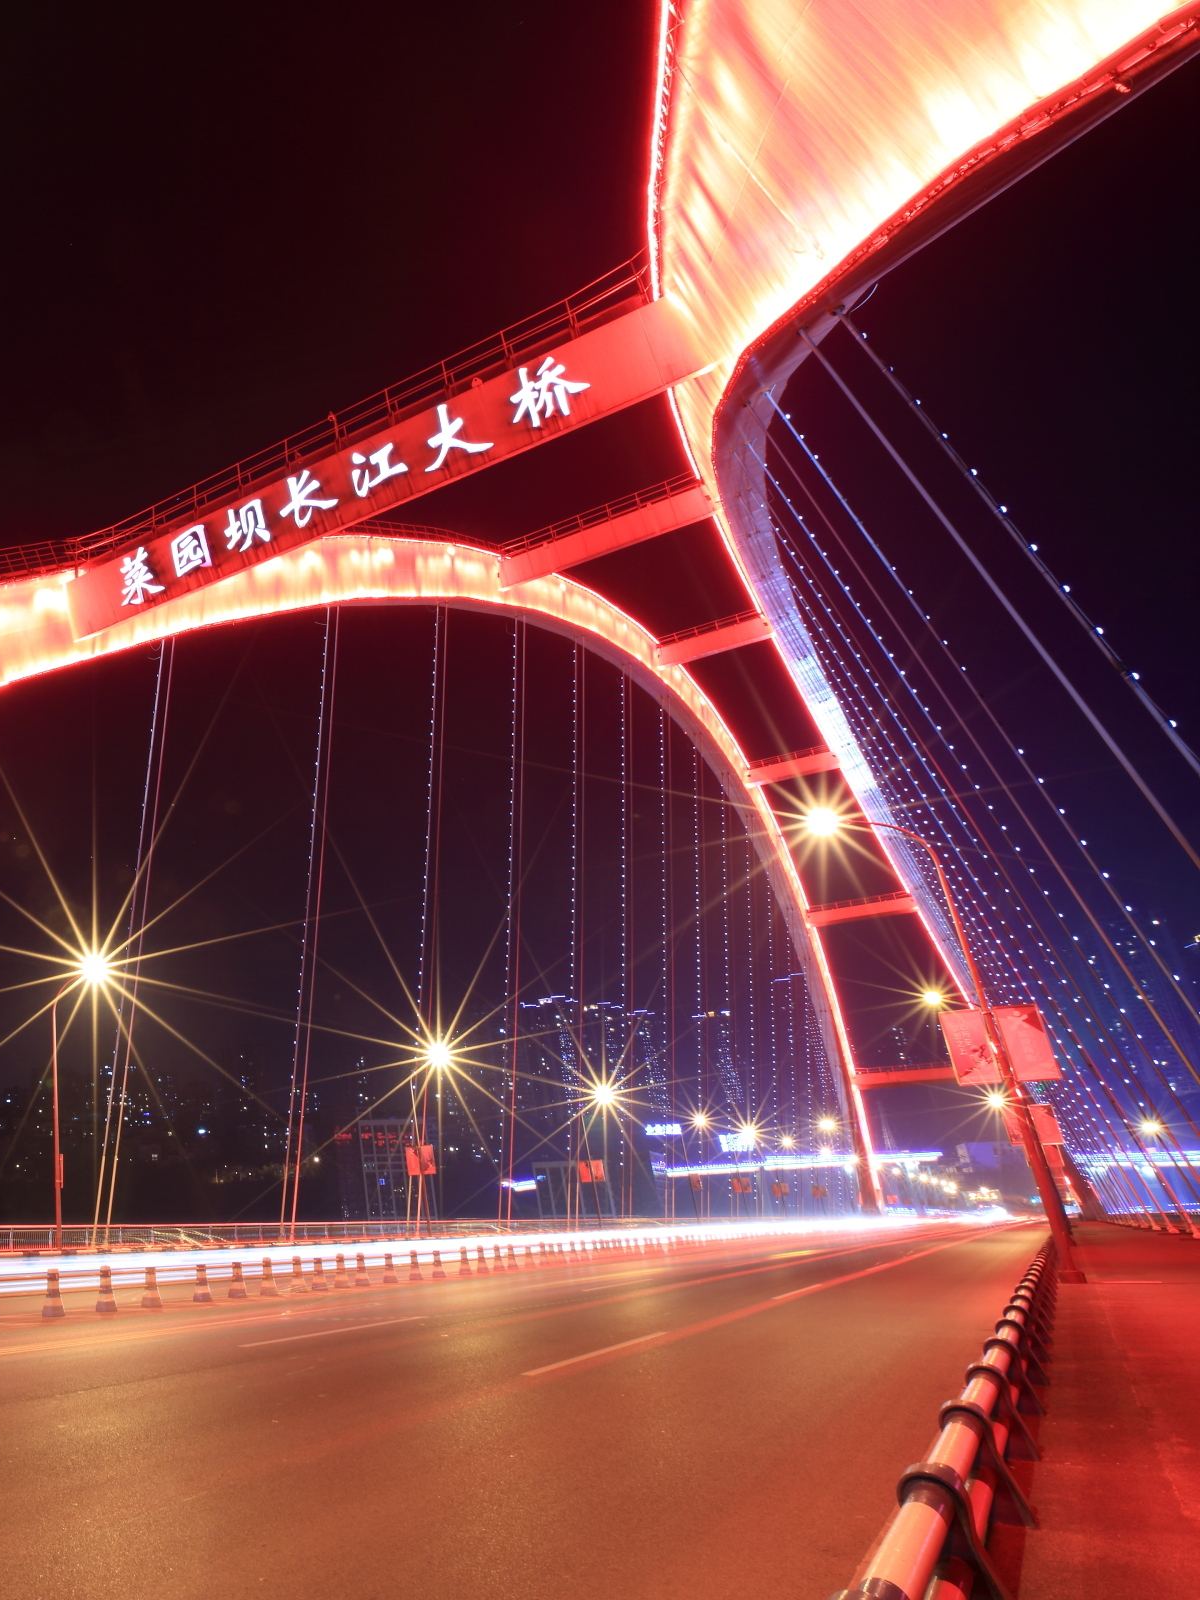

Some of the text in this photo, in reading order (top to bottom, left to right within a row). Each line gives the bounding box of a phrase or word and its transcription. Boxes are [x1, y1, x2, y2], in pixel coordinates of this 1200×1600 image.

[120, 357, 591, 606] 菜园坝长江大桥
